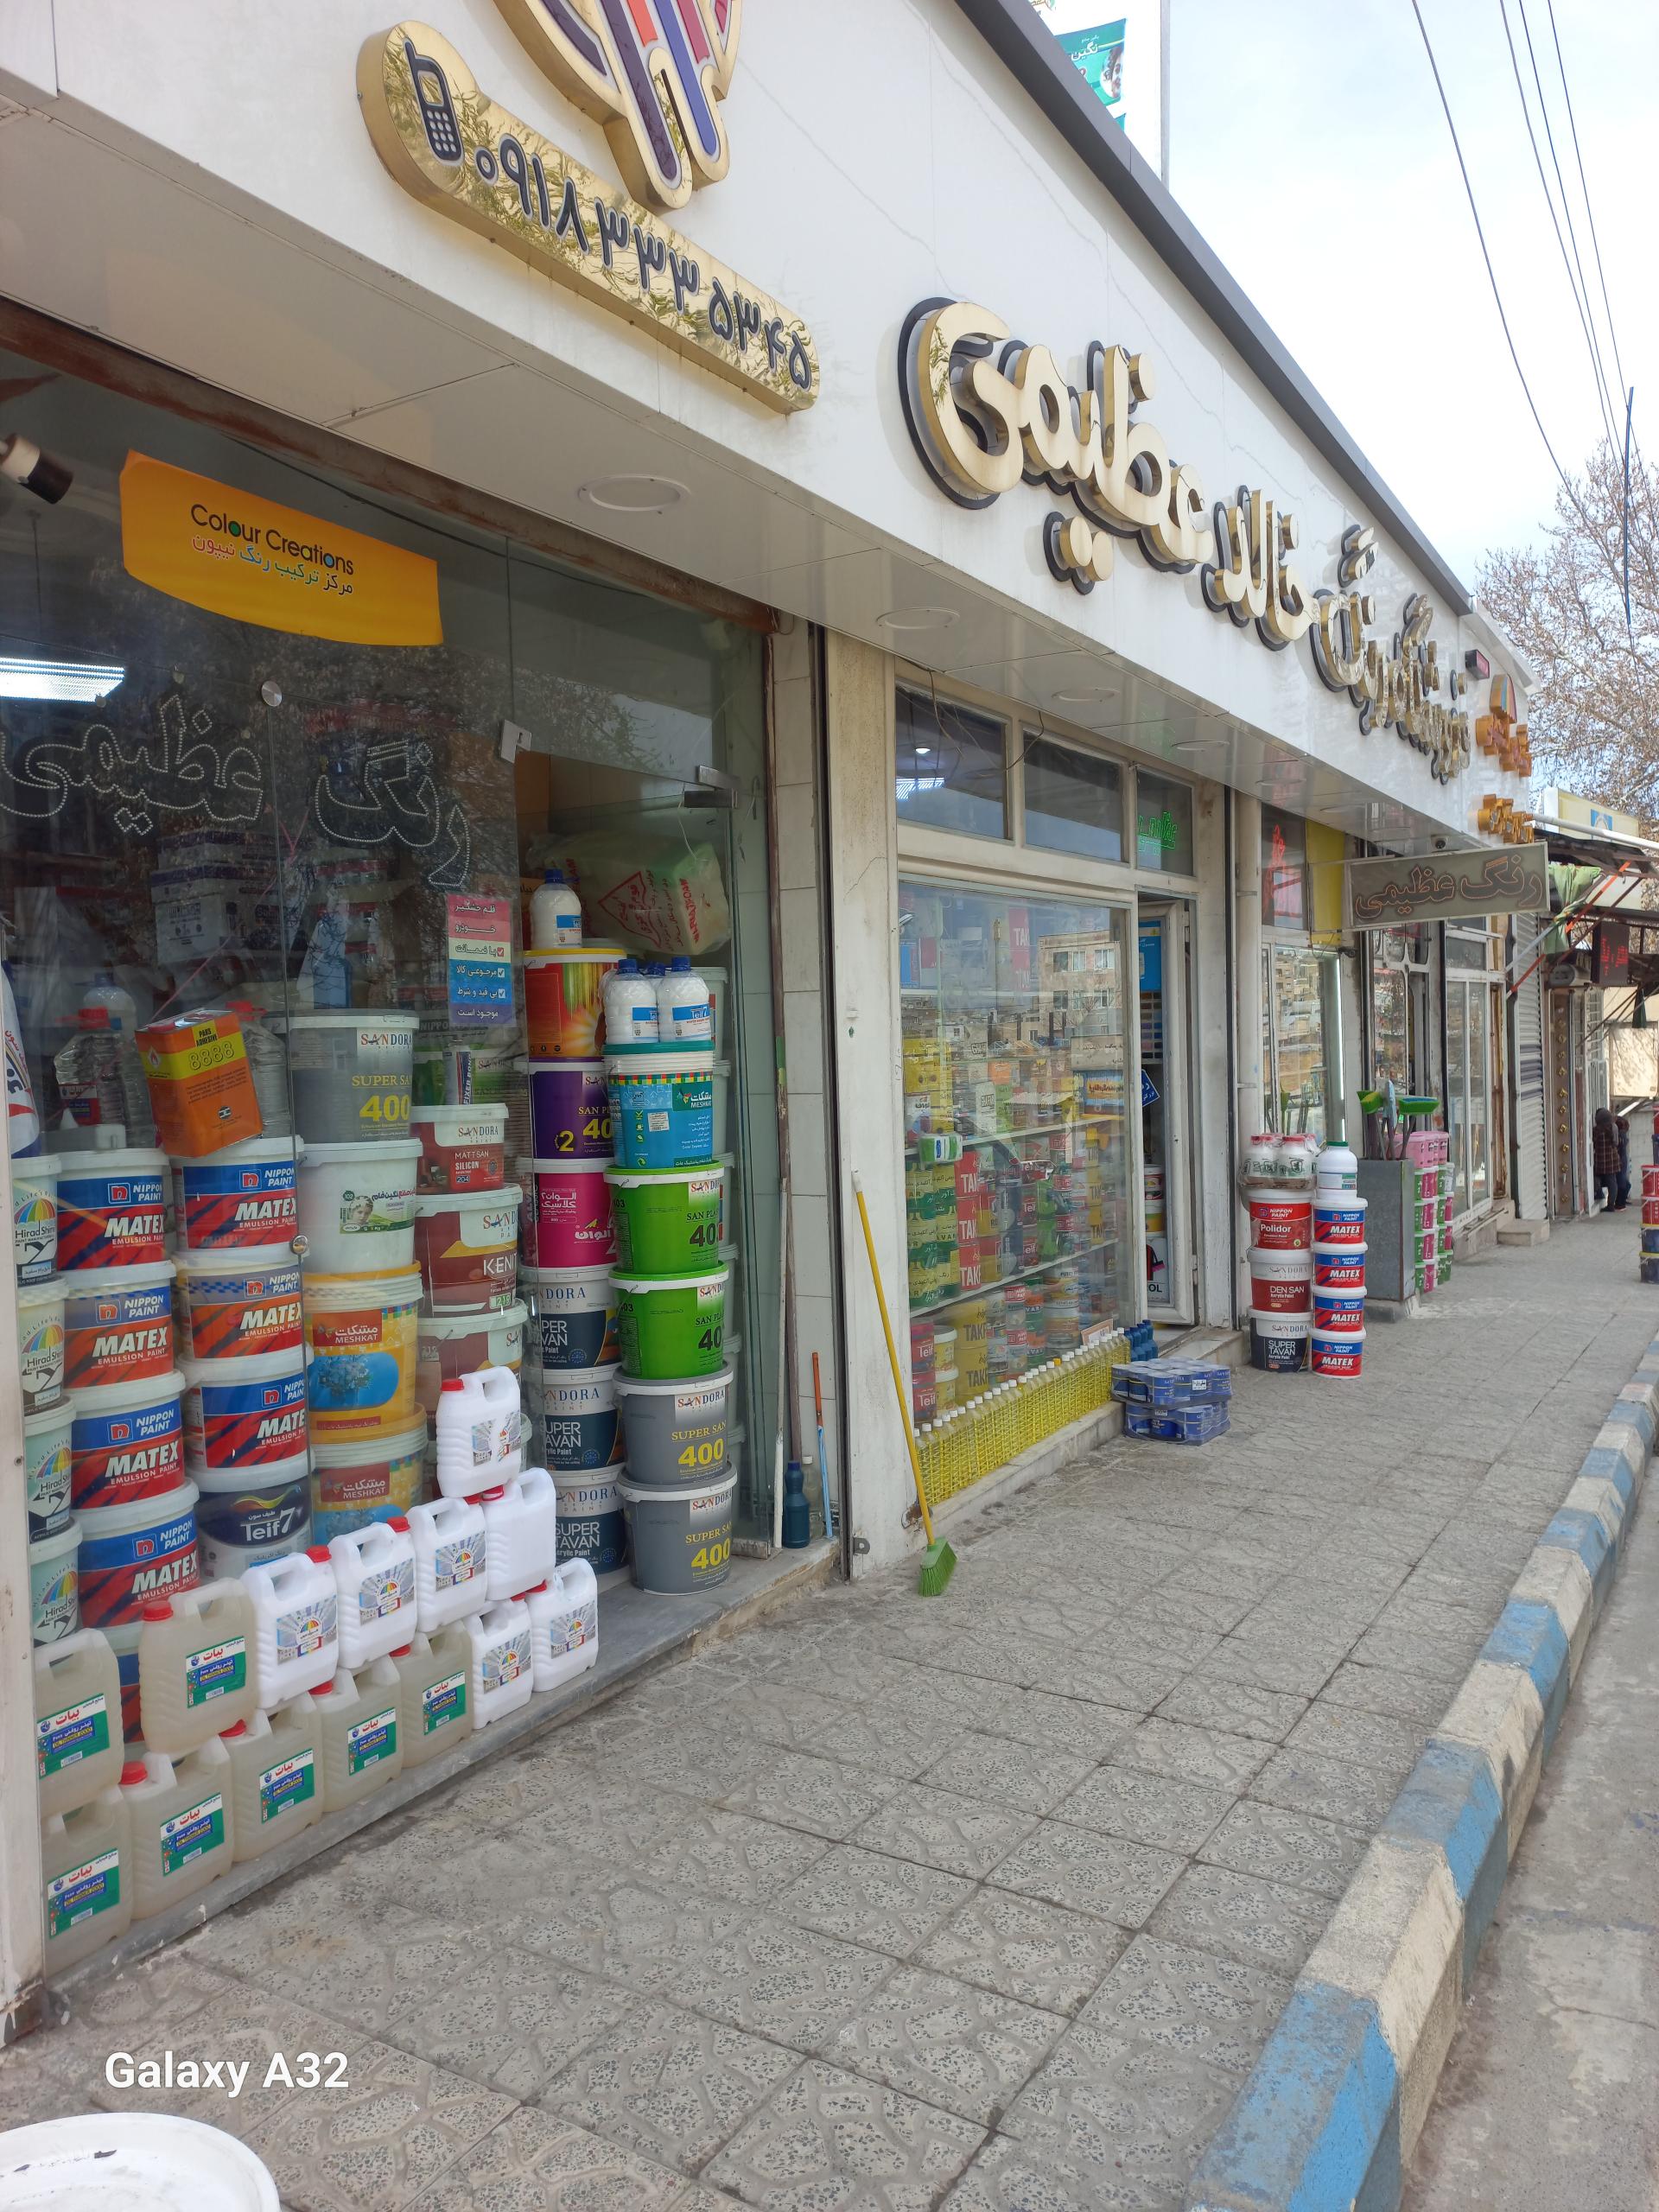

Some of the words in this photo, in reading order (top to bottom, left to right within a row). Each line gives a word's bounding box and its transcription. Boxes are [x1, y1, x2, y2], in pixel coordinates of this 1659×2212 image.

[901, 299, 1212, 592] عظیمی
[190, 504, 261, 544] Colour
[265, 529, 354, 575] Creations
[192, 534, 236, 561] نیپون
[239, 544, 270, 572] رنگ
[275, 562, 320, 586] ترکیب
[1203, 486, 1320, 650] خالد
[323, 574, 353, 595] مرکز
[0, 694, 263, 836] عظیمی
[315, 739, 471, 887] رنگ
[1461, 855, 1542, 908] رنگ
[1355, 865, 1455, 918] عظیمی
[457, 1008, 475, 1017] است
[476, 1011, 499, 1020] موجود
[199, 1027, 212, 1037] PARS
[360, 1034, 412, 1046] SANDORA
[188, 1041, 234, 1071] 8888
[352, 1076, 398, 1086] SUPER
[359, 1094, 411, 1122] 400
[578, 1106, 599, 1115] SAN
[458, 1126, 499, 1137] SANDORA
[559, 1130, 574, 1152] 2
[455, 1151, 475, 1160] MATT
[476, 1150, 489, 1159] SAN
[455, 1161, 480, 1170] SILICON
[268, 1176, 292, 1186] PAINT
[234, 1198, 296, 1221] MATEX
[686, 1211, 704, 1221] SAN
[239, 1219, 279, 1228] EMULSION
[1260, 1224, 1292, 1233] Polidor
[1330, 1225, 1360, 1234] MATEX
[15, 1225, 41, 1238] Hirad
[111, 1236, 151, 1245] EMULSION
[1330, 1269, 1360, 1278] MATEX
[272, 1281, 297, 1294] PAINT
[124, 1295, 164, 1308] NIPPON
[129, 1305, 160, 1318] PAINT
[239, 1302, 302, 1331] MATEX
[1332, 1313, 1360, 1322] MATEX
[542, 1320, 568, 1333] PER
[696, 1316, 711, 1325] SAN
[245, 1325, 285, 1337] EMULSION
[334, 1325, 378, 1336] مشکات
[92, 1327, 168, 1357] MATEX
[335, 1333, 378, 1344] MESHKAT
[541, 1333, 568, 1346] VAN
[27, 1353, 51, 1368] Hirad
[98, 1352, 143, 1365] EMULSION
[147, 1348, 165, 1357] PAINT
[1322, 1356, 1354, 1366] MATEX
[677, 1389, 725, 1408] SANDORA
[136, 1408, 174, 1427] NIPPON
[257, 1408, 305, 1439] MATE
[140, 1421, 170, 1435] PAINT
[546, 1421, 582, 1434] UPER
[671, 1426, 710, 1440] SUPER
[262, 1433, 296, 1446] EMULSION
[546, 1434, 582, 1447] AVAN
[105, 1440, 179, 1478] MATEX
[677, 1438, 724, 1467] 400
[111, 1470, 156, 1485] EMULSION
[159, 1462, 177, 1474] PAINT
[41, 1478, 61, 1491] Hirad
[342, 1478, 385, 1491] مشکات
[343, 1486, 385, 1499] MESHKAT
[248, 1512, 262, 1521] سون
[160, 1518, 193, 1541] NIPPON
[685, 1529, 721, 1543] SUPER
[164, 1531, 190, 1550] PAINT
[691, 1538, 731, 1570] 400
[131, 1550, 197, 1594] MATEX
[137, 1582, 180, 1600] EMULSION
[45, 1600, 68, 1618] Hirad
[203, 1648, 224, 1661] بیات
[434, 1681, 448, 1694] بیات
[55, 1709, 79, 1726] بیات
[362, 1719, 378, 1732] بیات
[276, 1763, 293, 1777] بیات
[180, 1808, 200, 1825] بیات
[69, 1866, 92, 1883] بیات
